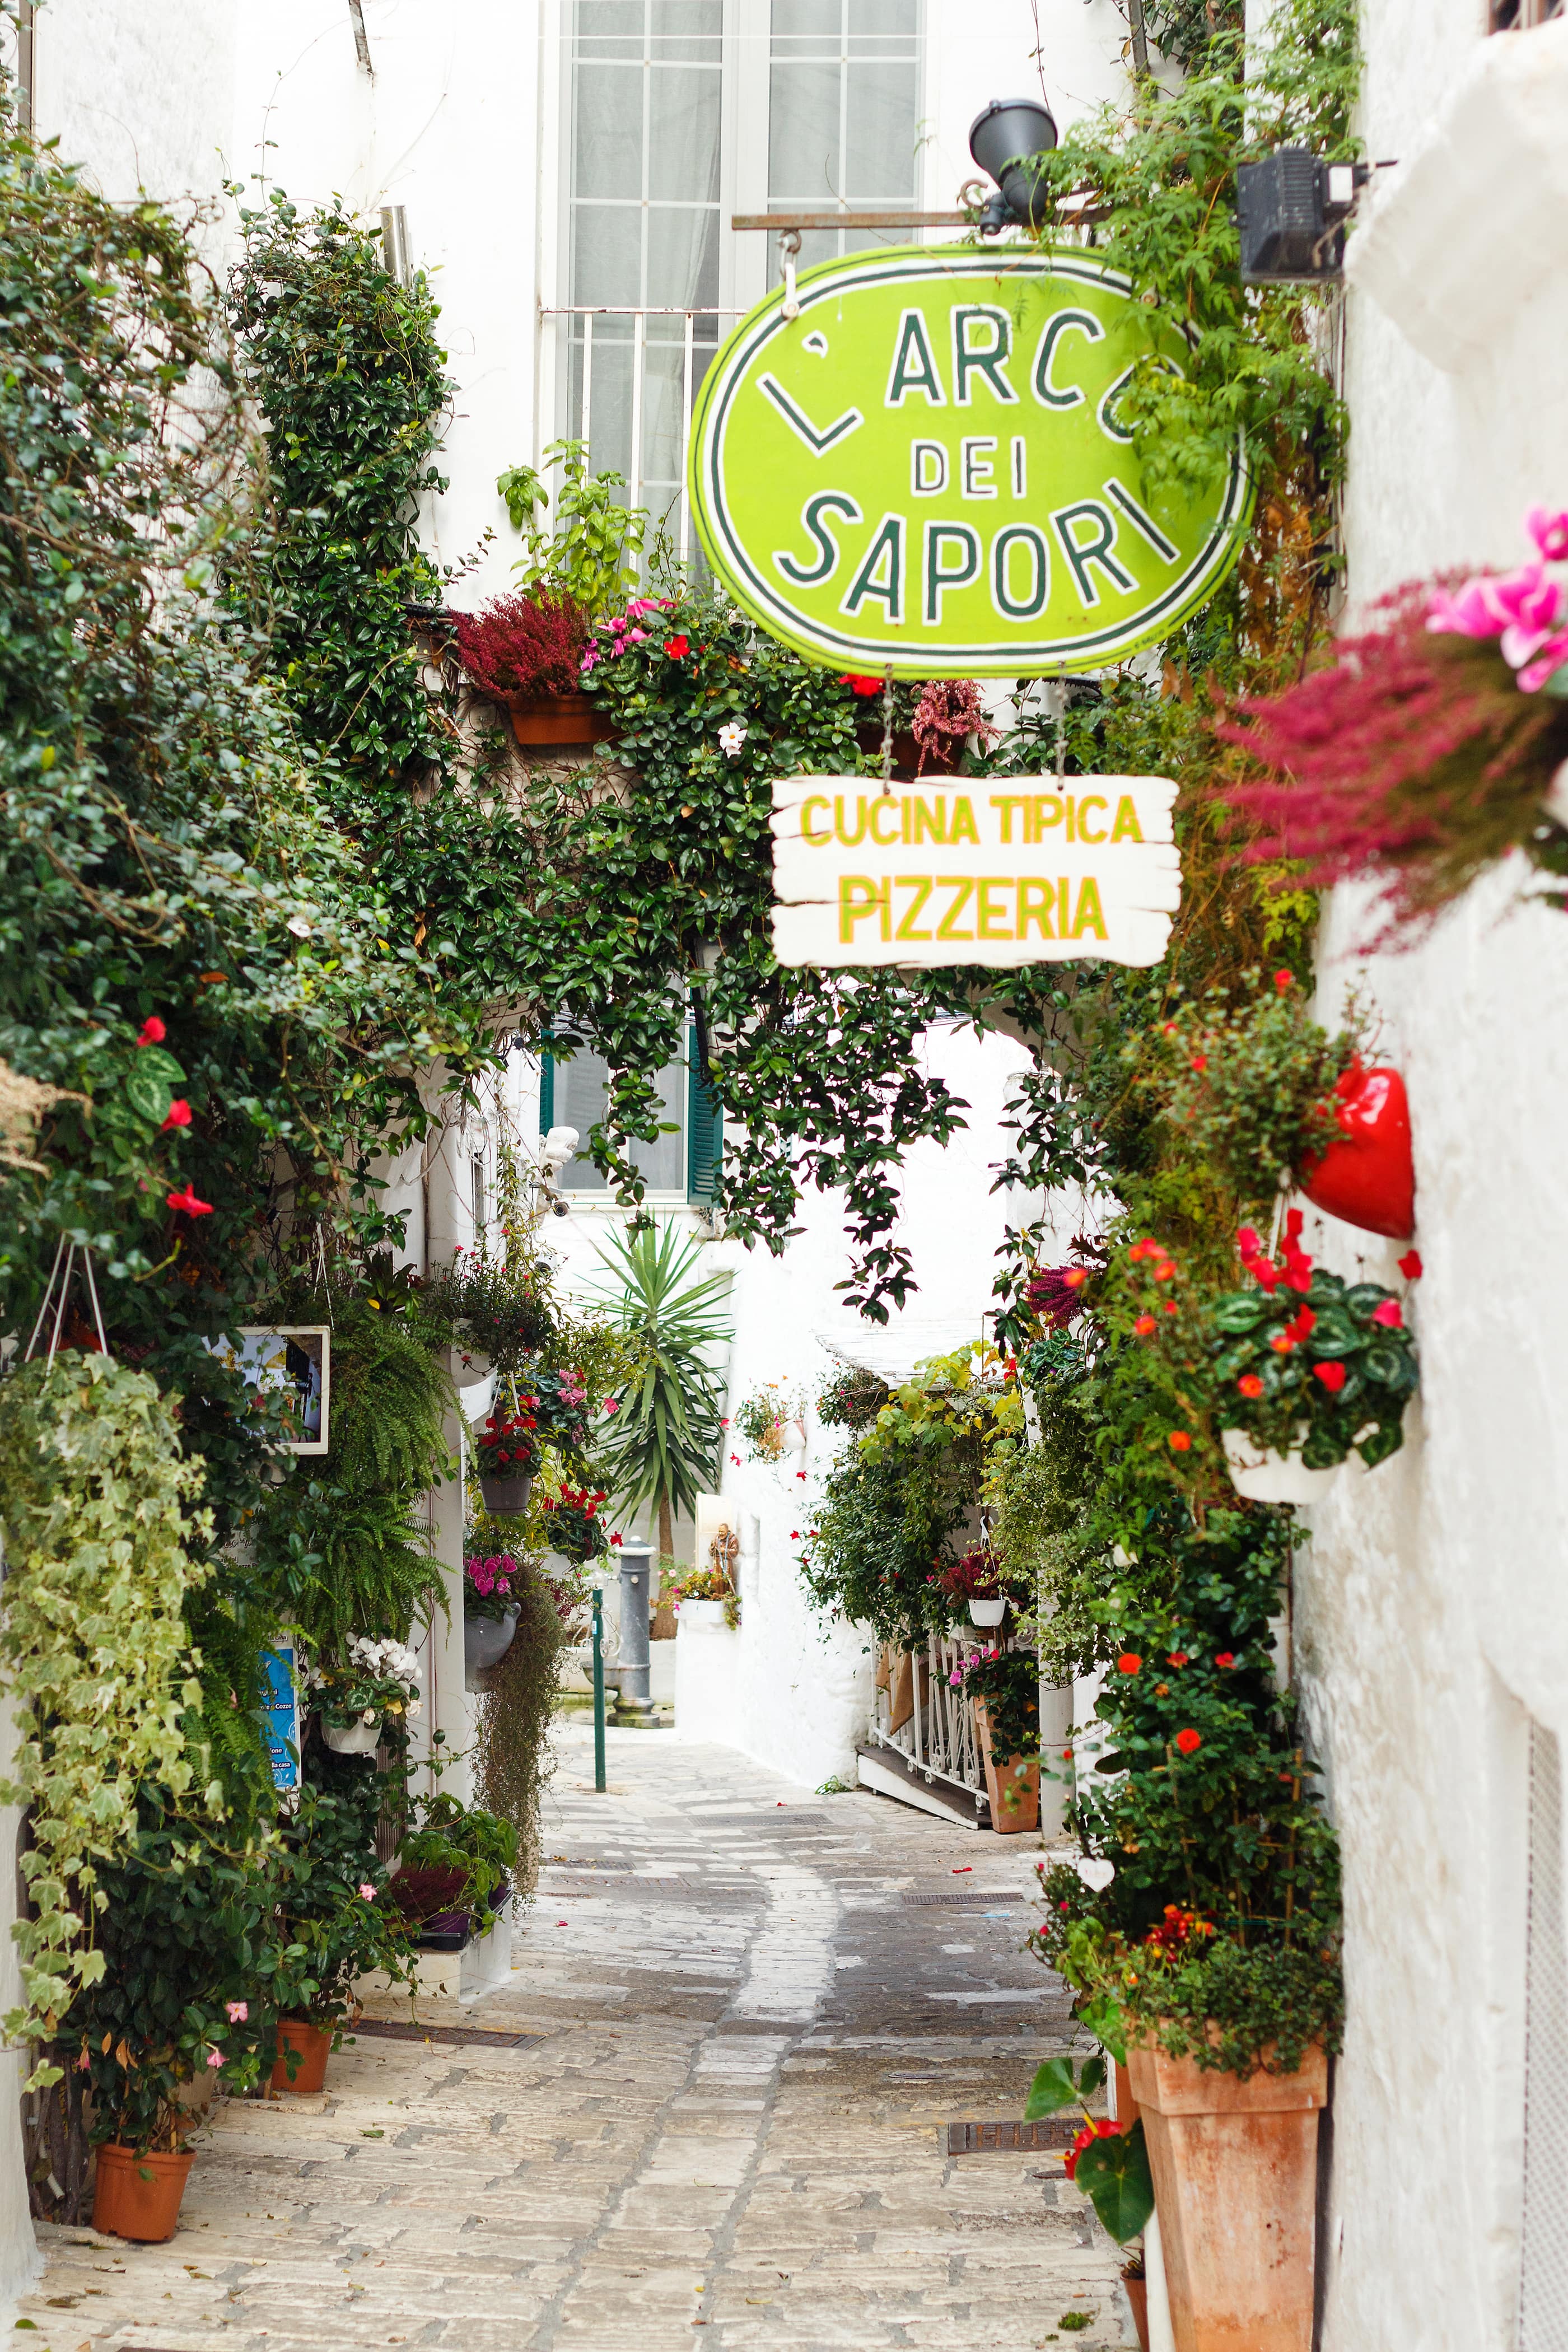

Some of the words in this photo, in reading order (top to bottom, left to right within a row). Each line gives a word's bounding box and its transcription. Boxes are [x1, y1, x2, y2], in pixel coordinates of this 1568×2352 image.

[910, 435, 1026, 499] DEI
[772, 477, 1180, 626] SAPORI
[800, 794, 980, 847] CUCINA
[990, 795, 1144, 844] TIPICA
[838, 875, 1109, 944] PIZZERIA
